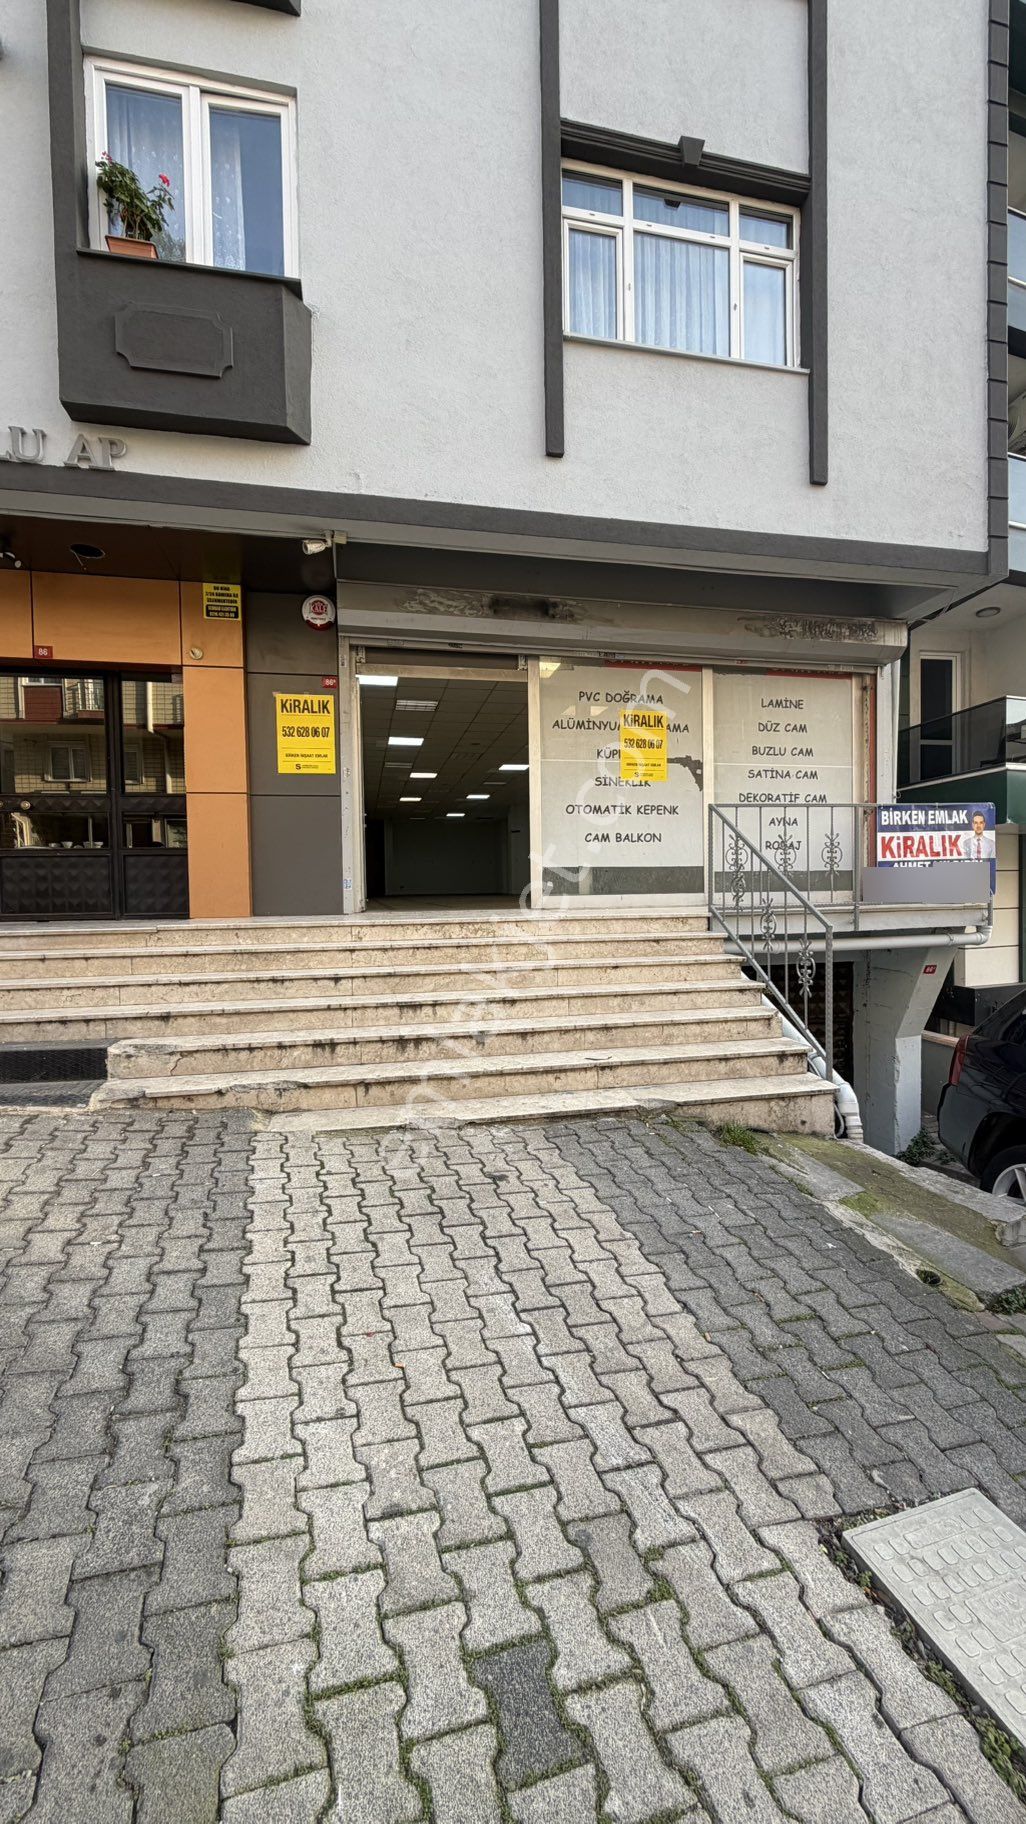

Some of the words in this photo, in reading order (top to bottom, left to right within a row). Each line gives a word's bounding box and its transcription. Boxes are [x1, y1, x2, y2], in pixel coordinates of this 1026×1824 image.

[0, 425, 46, 463] U
[64, 433, 126, 470] AP
[578, 691, 601, 702] PVC
[605, 690, 664, 704] DOĞRAMA
[761, 697, 804, 710] LAMİNE
[552, 717, 620, 731] ALÜMİNYU
[757, 720, 780, 733] DÜZ
[784, 723, 808, 734] CAM
[282, 726, 295, 737] 532
[296, 726, 310, 738] 628
[311, 727, 320, 738] 06
[321, 727, 330, 738] 07
[636, 739, 646, 749] 628
[751, 746, 786, 757] BUZLU
[791, 747, 814, 757] CAM
[748, 768, 791, 780] SATİNA
[795, 770, 819, 780] CAM
[738, 792, 801, 804] DEKORATİF
[804, 793, 828, 804] CAM
[565, 803, 632, 815] OTOMATİK
[636, 804, 679, 816] KEPENK
[768, 816, 799, 827] AYNA
[881, 808, 925, 826] BİRKEN
[927, 809, 969, 825] EMLAK
[584, 832, 611, 843] CAM
[615, 832, 662, 843] BALKON
